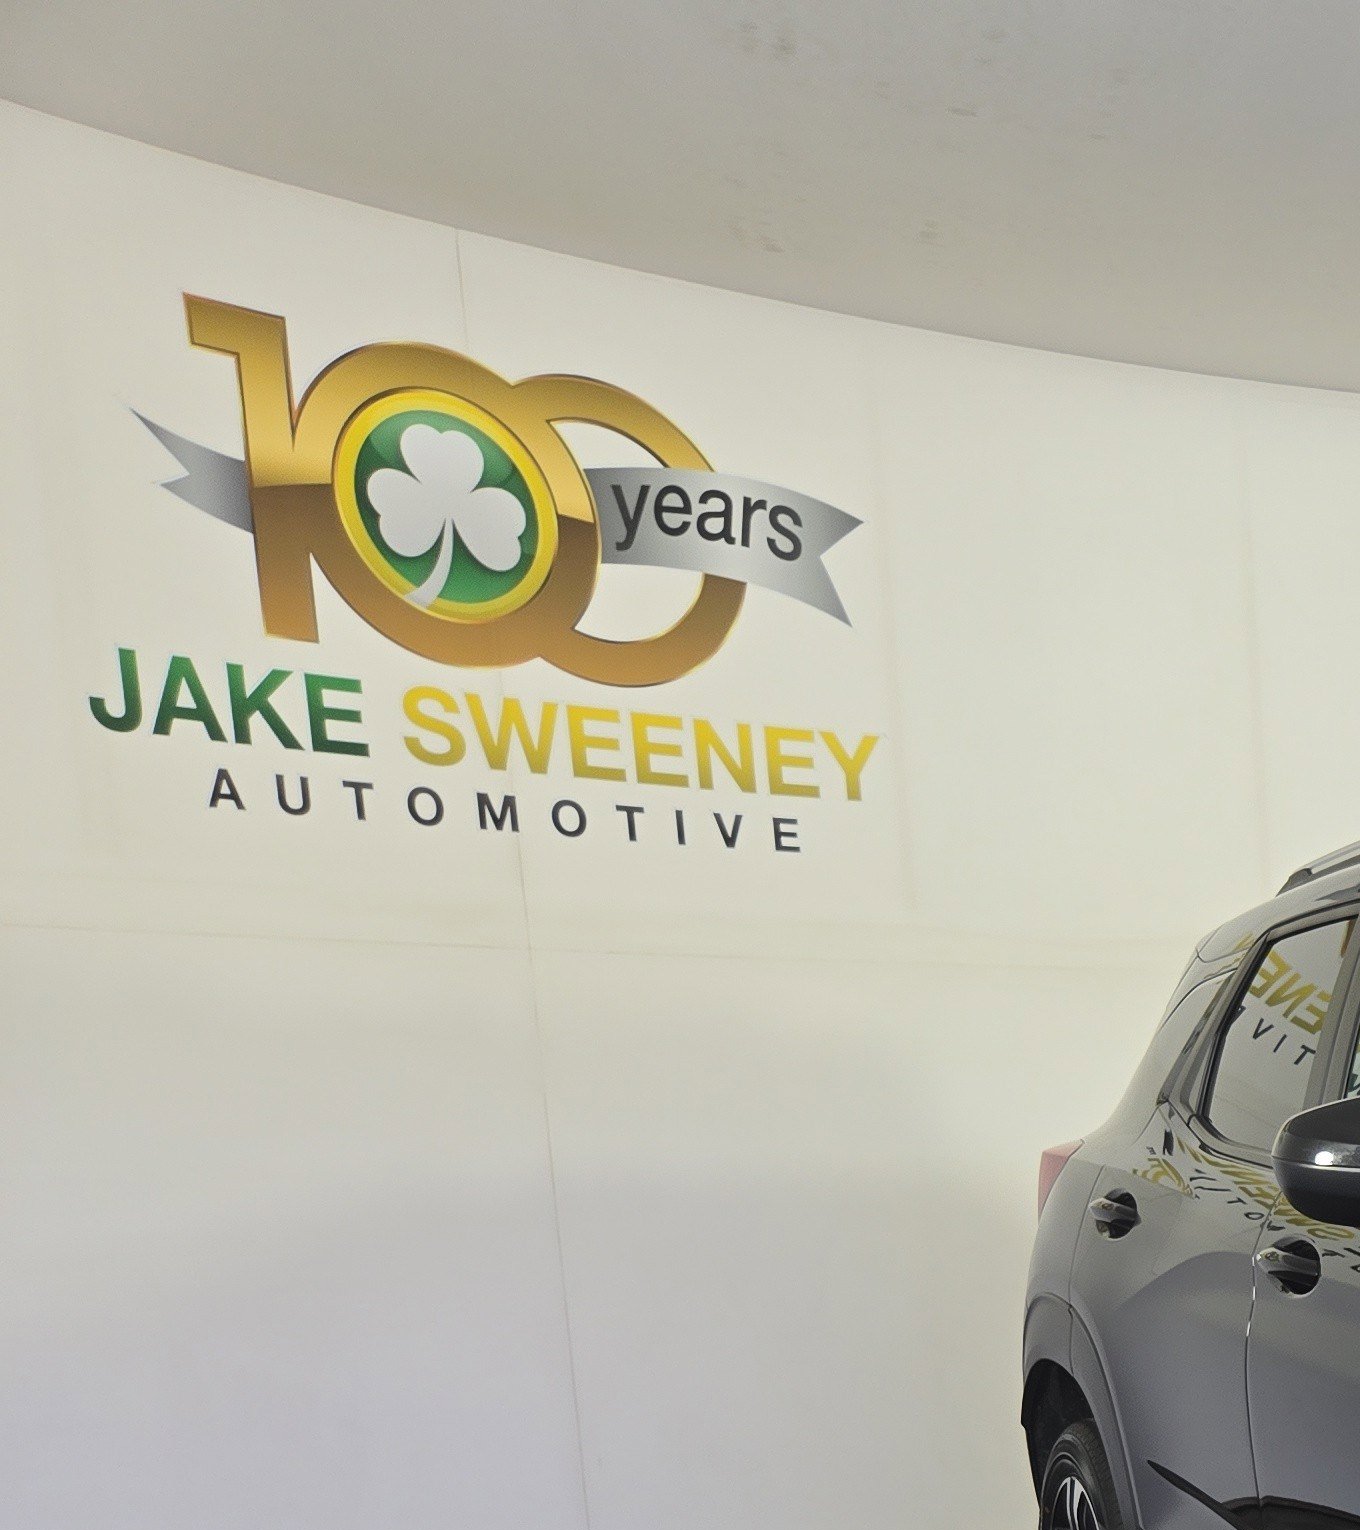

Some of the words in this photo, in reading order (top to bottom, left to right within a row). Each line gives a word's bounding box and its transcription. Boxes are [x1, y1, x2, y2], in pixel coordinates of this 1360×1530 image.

[610, 482, 804, 562] years
[89, 647, 370, 757] JAKE
[402, 685, 880, 801] SWEENEY
[209, 768, 802, 853] AUTOMOTIVE
